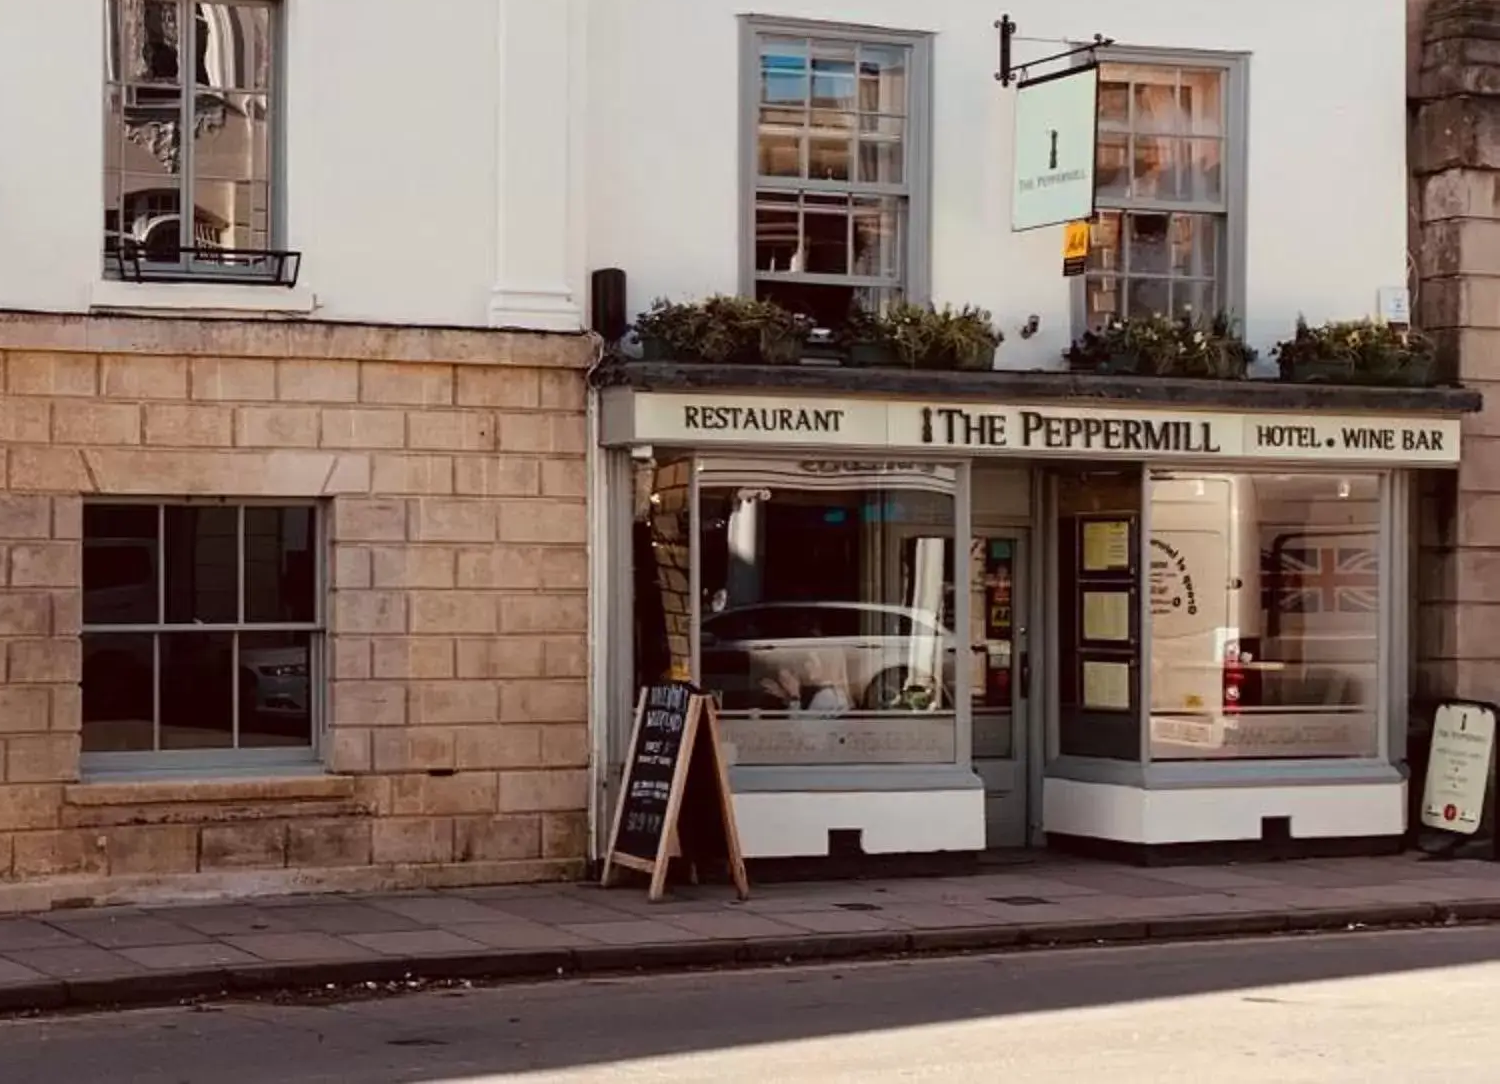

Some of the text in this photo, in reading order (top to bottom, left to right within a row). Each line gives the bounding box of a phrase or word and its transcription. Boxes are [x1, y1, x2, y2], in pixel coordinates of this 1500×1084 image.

[684, 405, 845, 433] RESTAURANT
[937, 408, 1221, 453] THE PEPPERMILL
[1257, 425, 1444, 452] HOTEL WINE BAR
